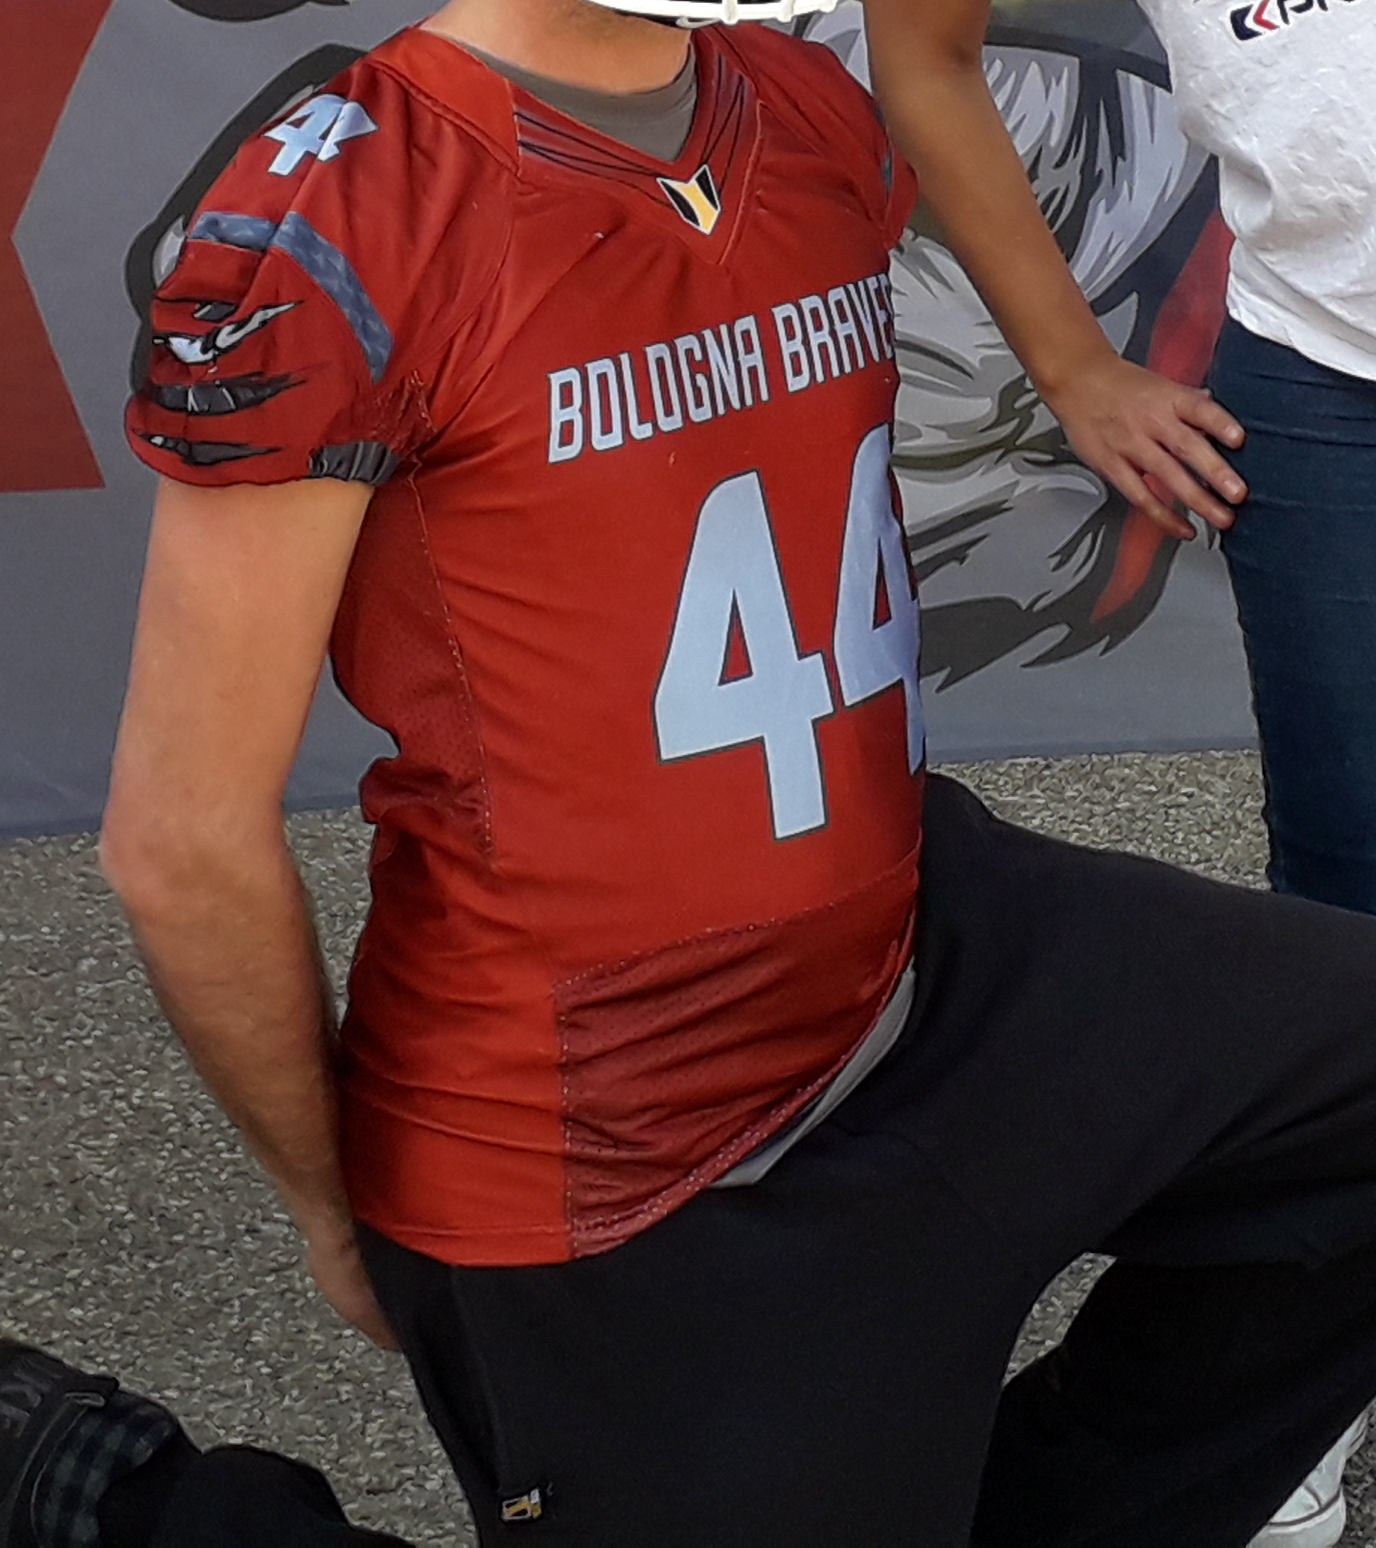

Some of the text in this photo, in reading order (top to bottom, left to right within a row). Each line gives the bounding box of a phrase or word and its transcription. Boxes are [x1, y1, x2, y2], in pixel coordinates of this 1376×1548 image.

[547, 271, 895, 464] BOLOGNA BRAVE
[652, 421, 926, 841] 44
